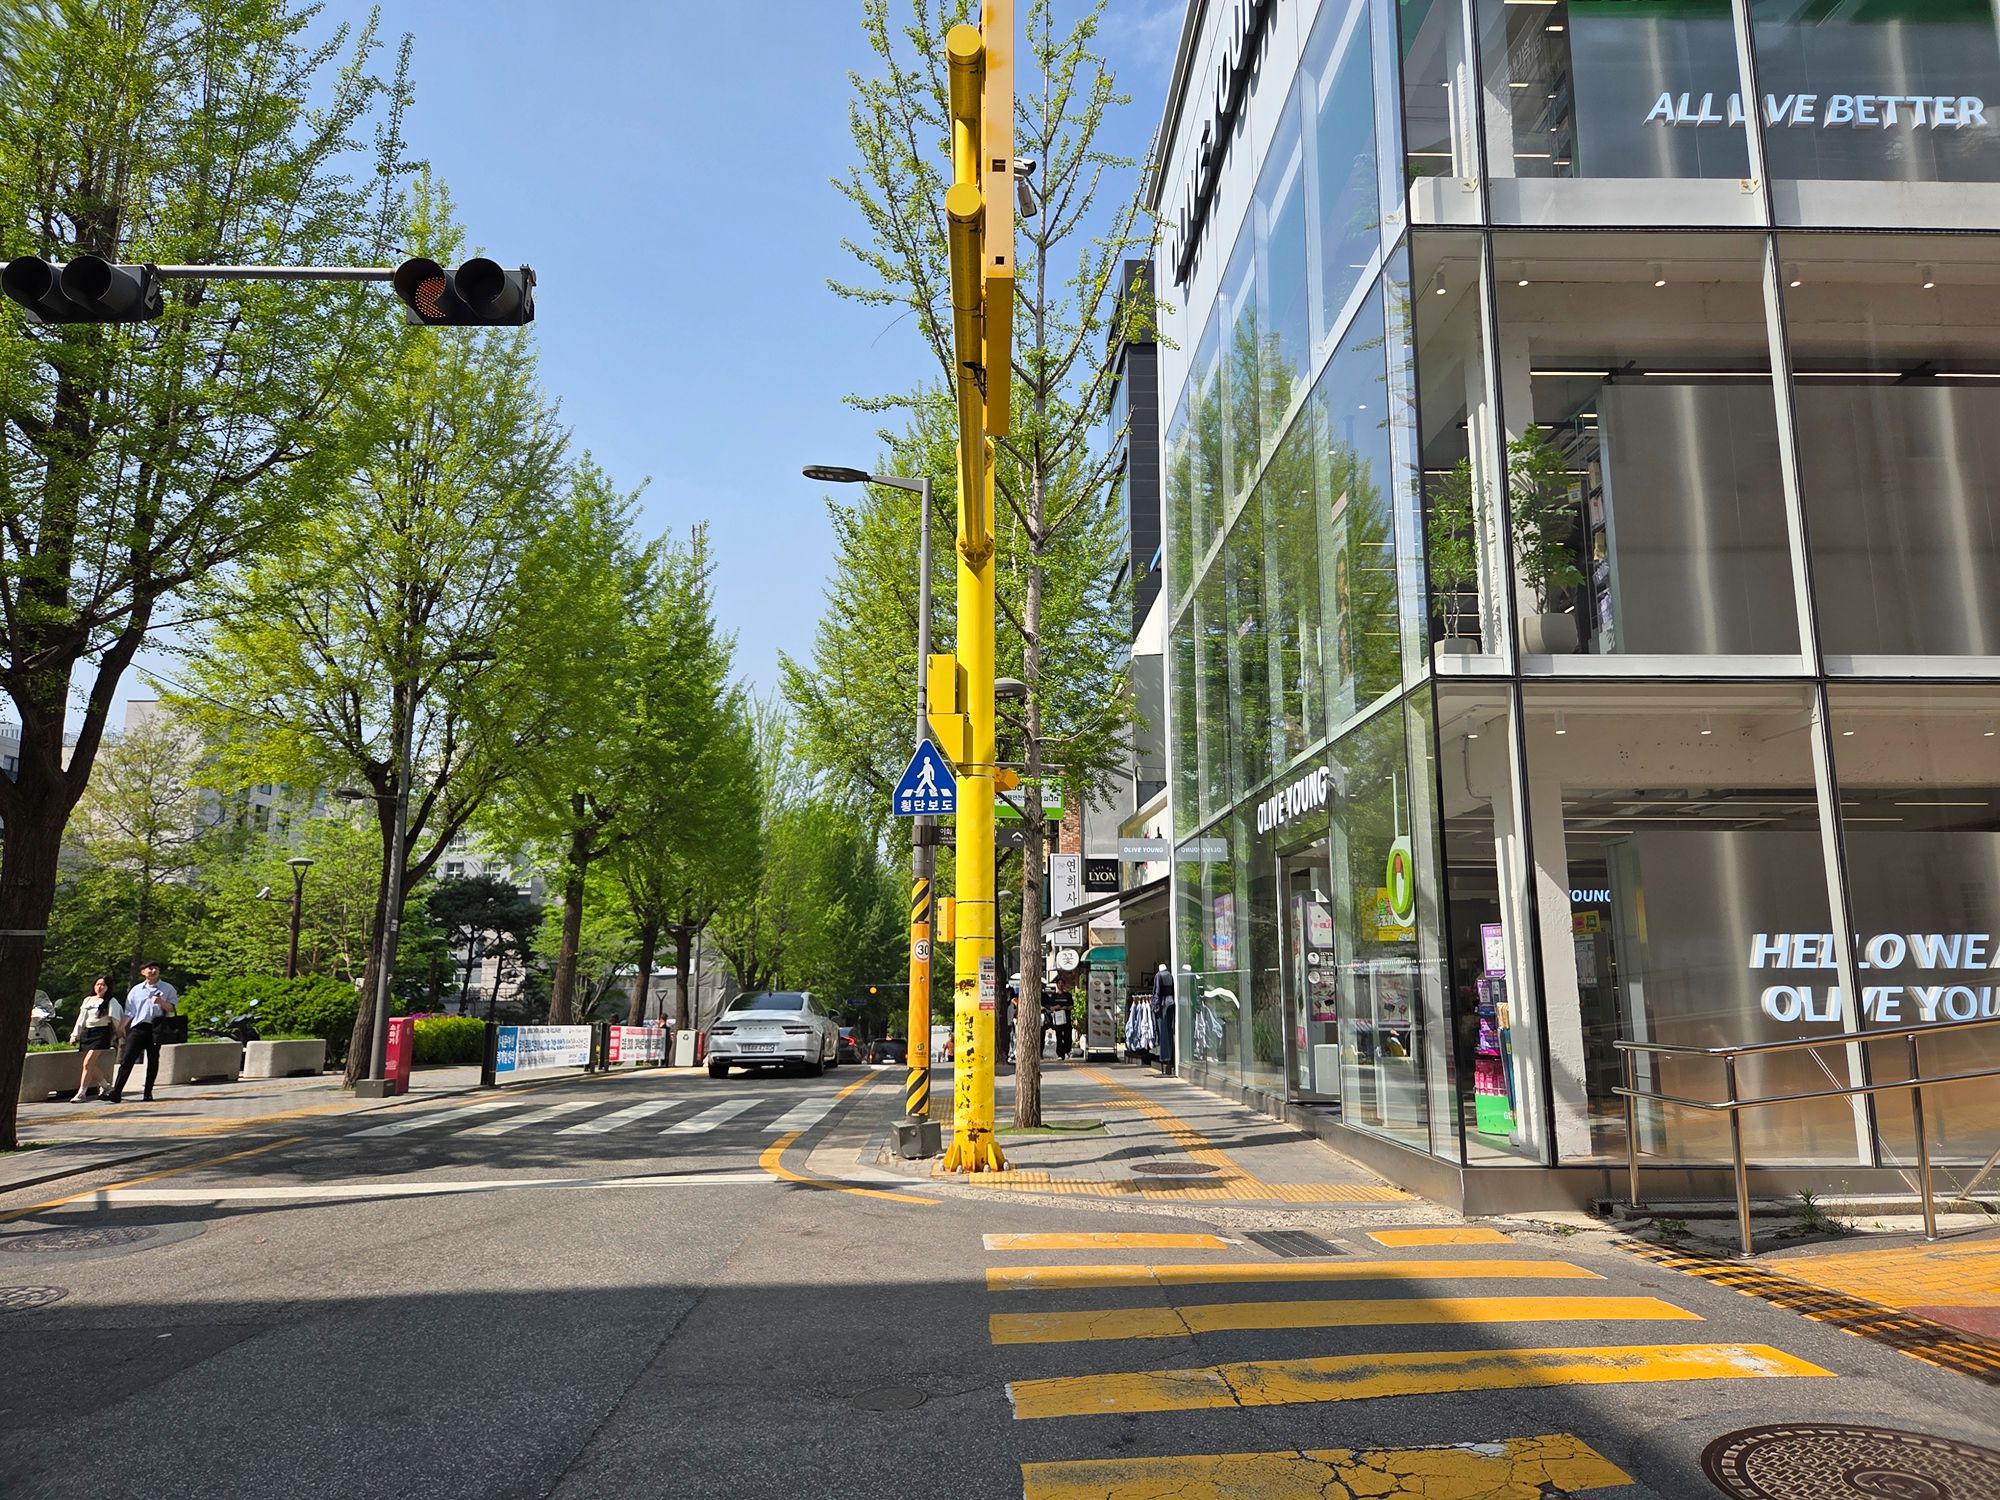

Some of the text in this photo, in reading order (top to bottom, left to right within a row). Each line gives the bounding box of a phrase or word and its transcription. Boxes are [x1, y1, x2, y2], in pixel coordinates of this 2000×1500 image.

[1643, 92, 1989, 127] ALL LVE BETTER
[900, 799, 954, 812] 횡단보도
[1257, 766, 1330, 835] OLIVE YOUNG
[1088, 871, 1117, 882] LYON
[1066, 858, 1078, 939] 연희사관
[1568, 889, 1611, 903] OUN
[917, 944, 929, 956] 30
[1908, 933, 1990, 970] WE
[1062, 953, 1074, 966] 꽃
[388, 1024, 396, 1045] 소화기
